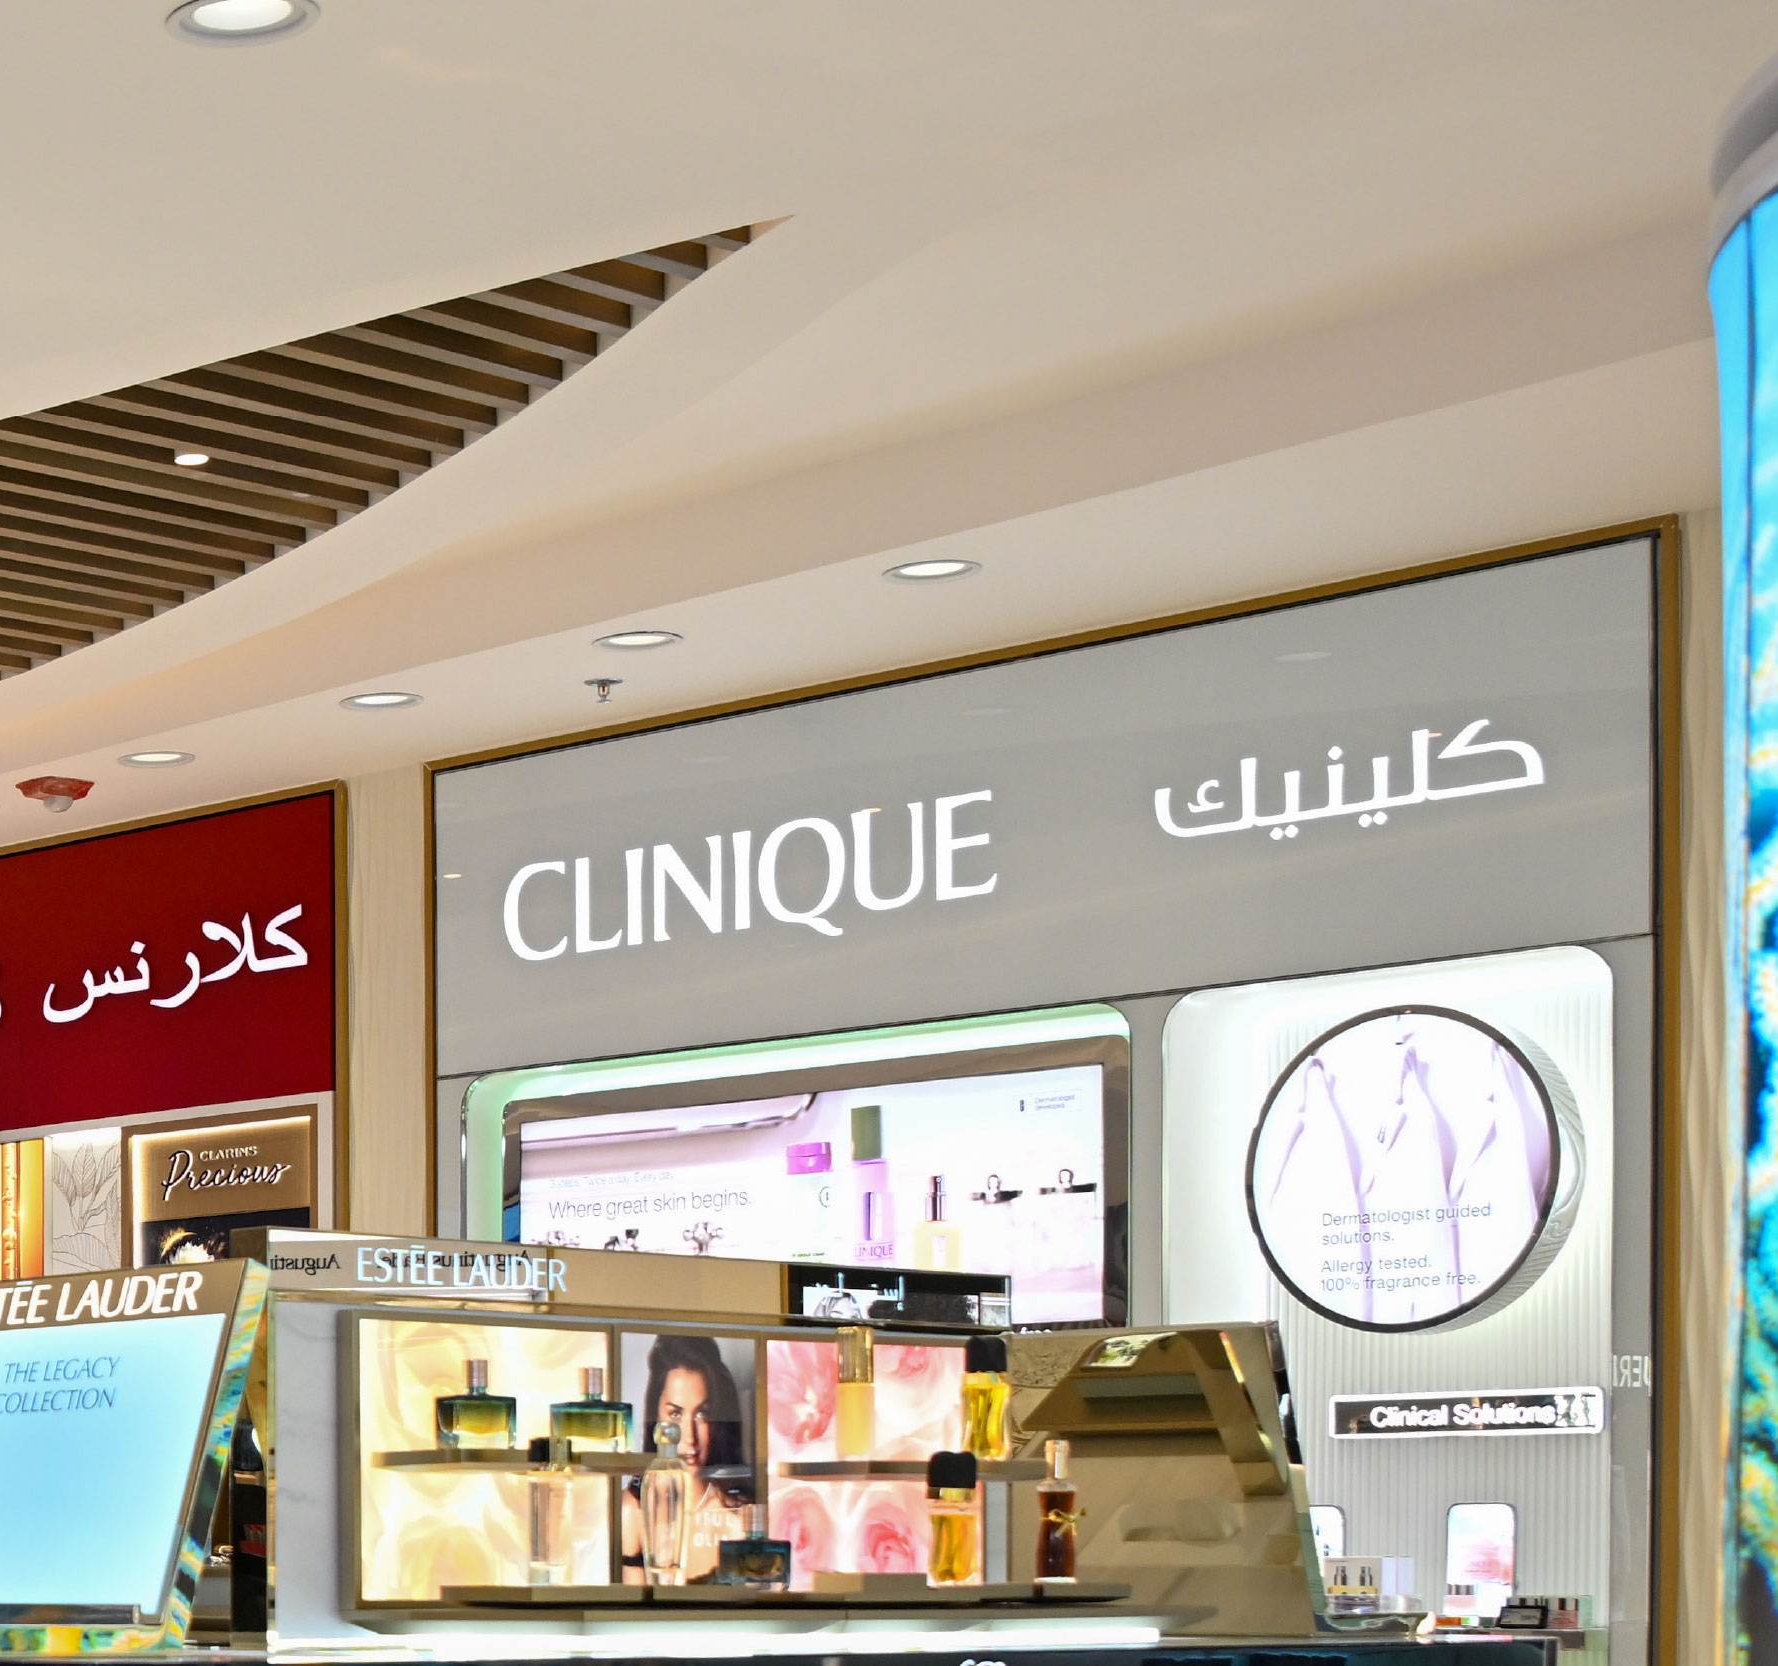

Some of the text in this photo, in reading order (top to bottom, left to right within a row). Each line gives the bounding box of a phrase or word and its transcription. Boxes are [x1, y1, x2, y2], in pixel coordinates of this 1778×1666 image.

[1153, 719, 1546, 840] كلينيك
[503, 789, 997, 962] CLINIQUE
[43, 905, 308, 1023] كلارنس
[199, 1146, 258, 1162] CLARINS
[161, 1149, 292, 1201] Precious
[549, 1190, 751, 1219] Where great skin begins.
[1322, 1203, 1491, 1227] Dermatologist guided
[1322, 1229, 1395, 1245] solutions.
[453, 1252, 568, 1292] LAUDER
[1321, 1255, 1432, 1275] Allergy tested.
[1321, 1271, 1481, 1291] 100% fragrance free.
[55, 1270, 203, 1323] LAUDER
[3, 1356, 121, 1384] THE LEGACY
[1369, 1403, 1449, 1428] Clinical
[1453, 1402, 1556, 1427] Solutions
